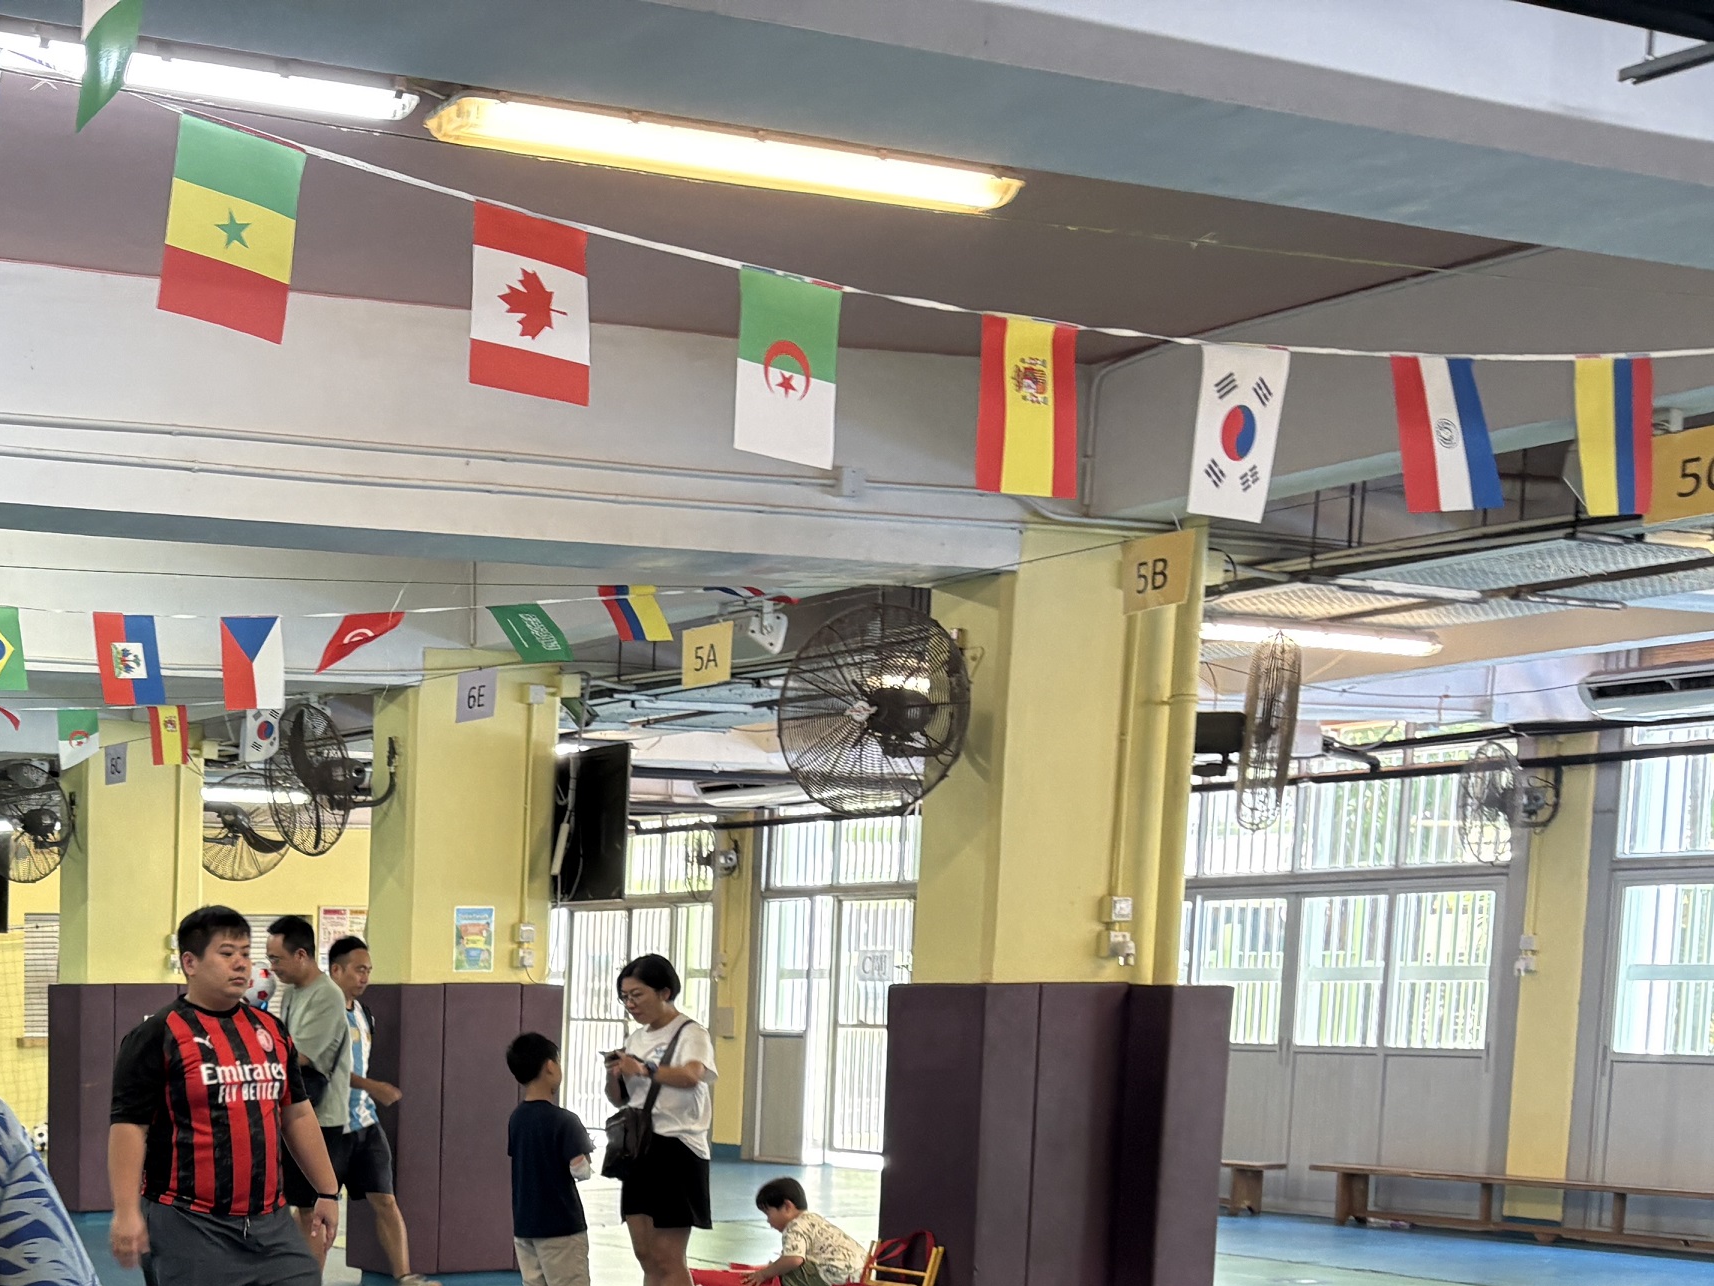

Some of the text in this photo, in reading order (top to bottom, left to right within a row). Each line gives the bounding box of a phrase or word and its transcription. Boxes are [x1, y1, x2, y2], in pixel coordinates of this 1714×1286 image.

[1136, 558, 1168, 594] 5B
[694, 643, 718, 672] 5A
[467, 684, 486, 709] 6E
[200, 1060, 286, 1085] Emirates
[218, 1081, 280, 1104] FLY BETTER
